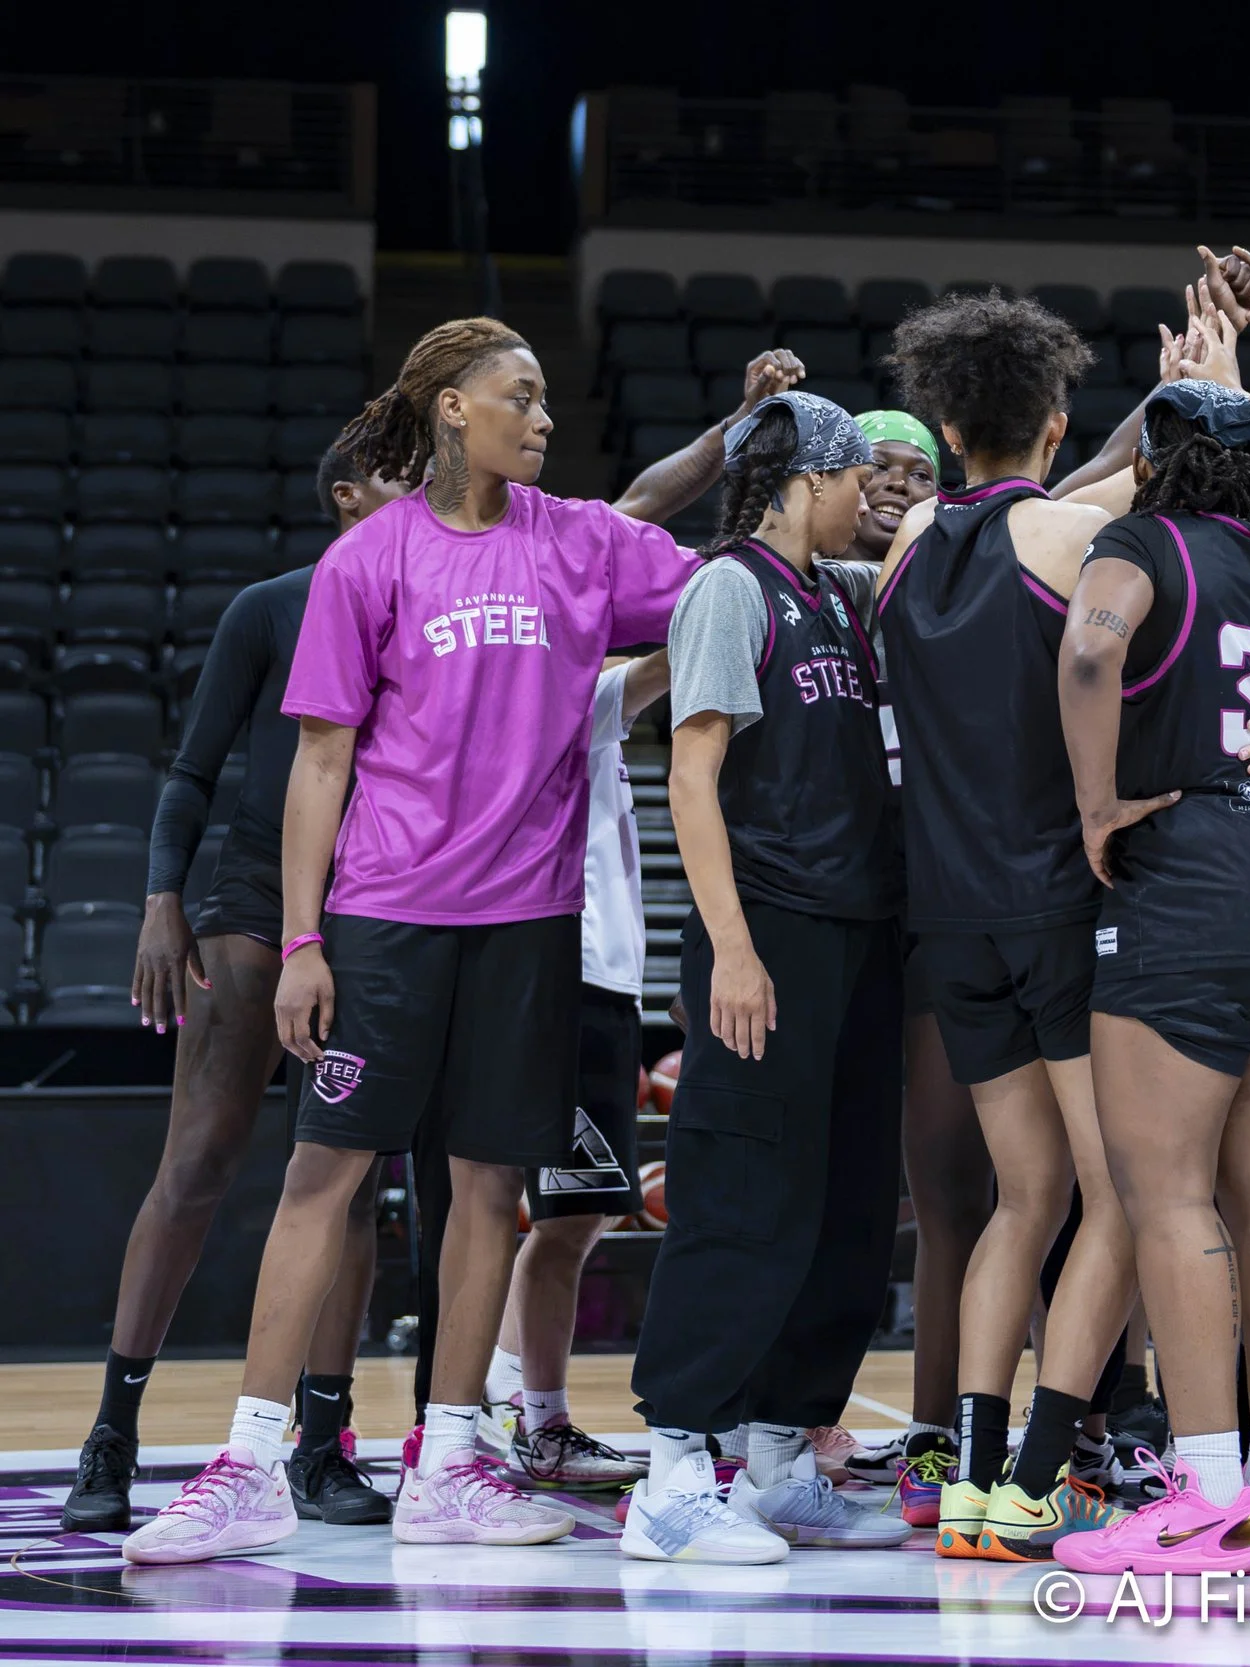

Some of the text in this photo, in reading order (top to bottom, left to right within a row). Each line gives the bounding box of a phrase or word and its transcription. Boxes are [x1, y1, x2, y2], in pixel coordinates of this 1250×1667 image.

[455, 592, 525, 608] SAVANNAH
[1083, 607, 1129, 639] 1995
[316, 1061, 362, 1083] STEEL
